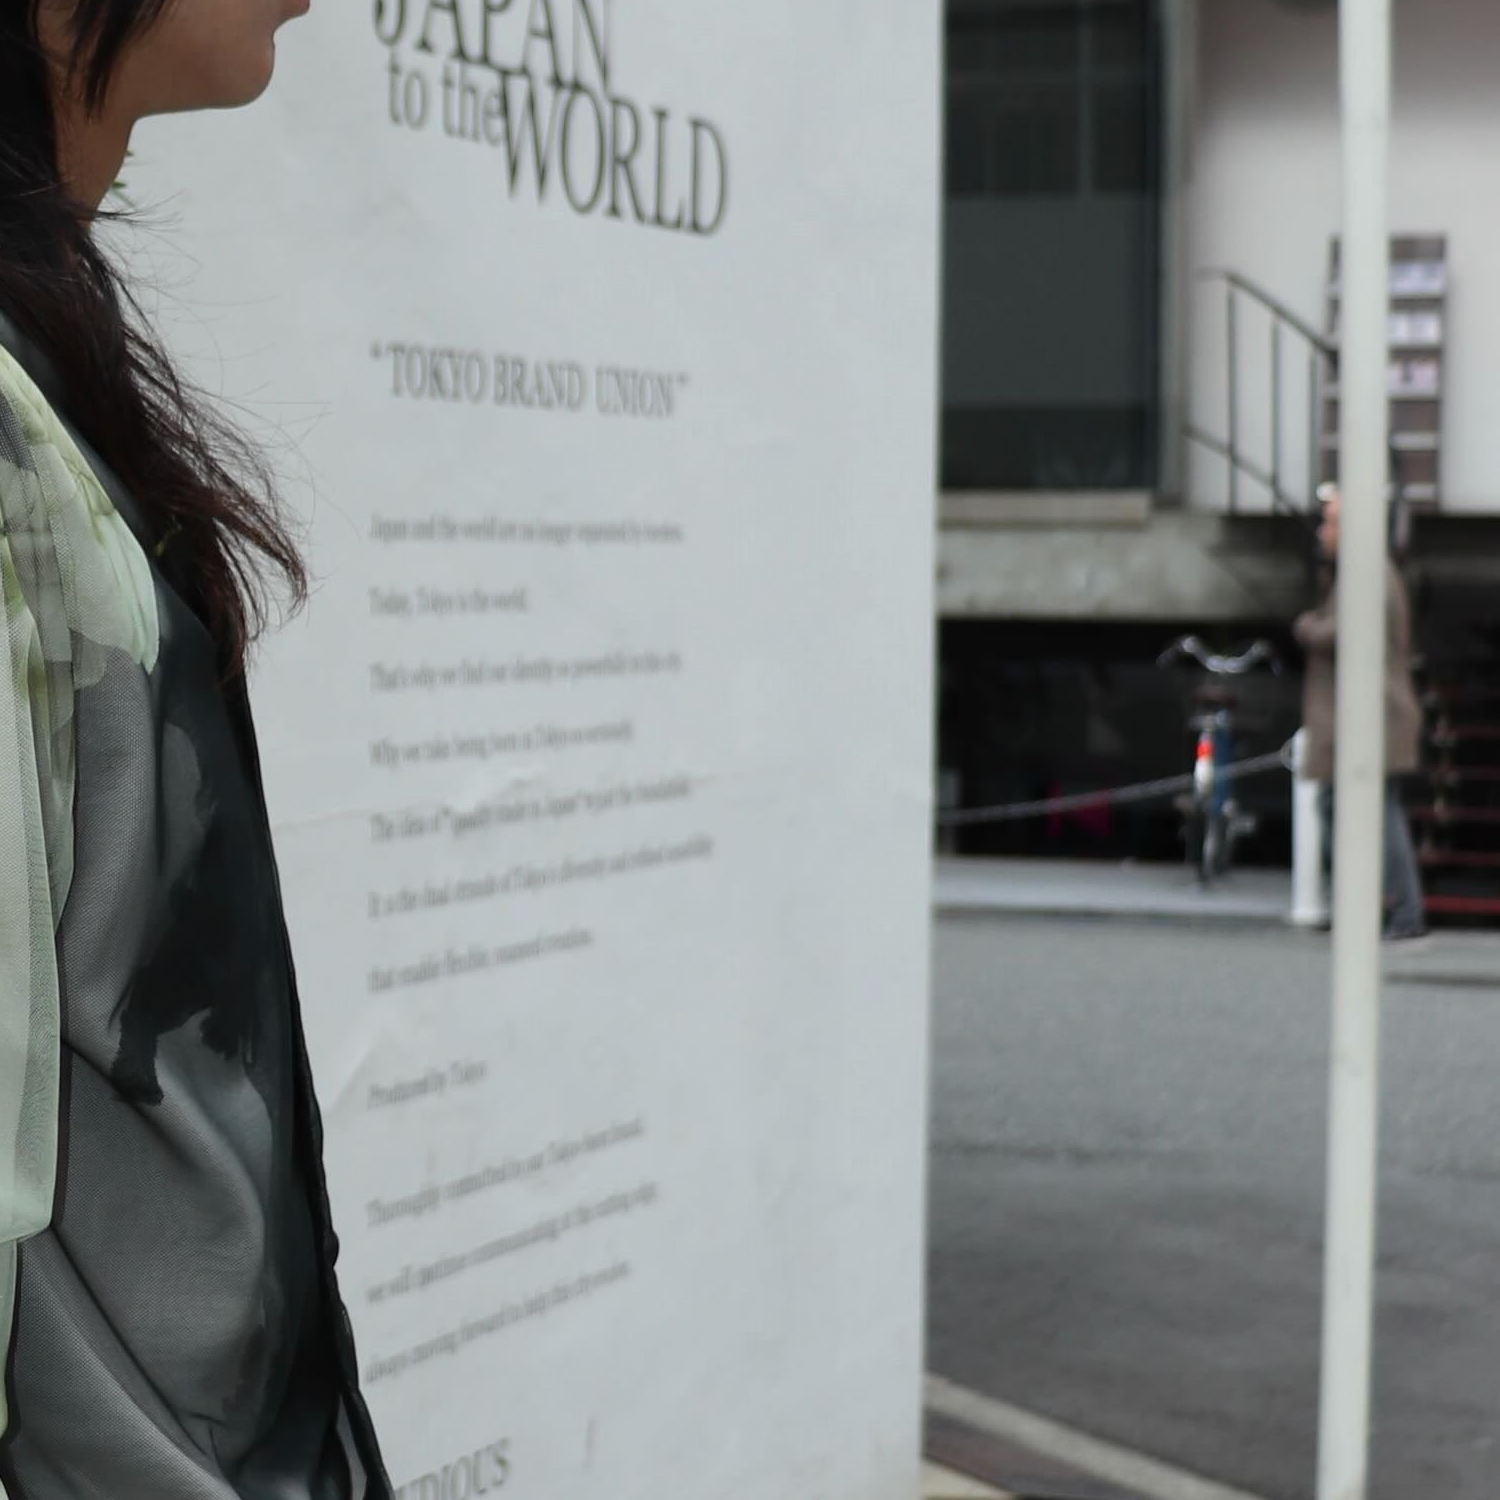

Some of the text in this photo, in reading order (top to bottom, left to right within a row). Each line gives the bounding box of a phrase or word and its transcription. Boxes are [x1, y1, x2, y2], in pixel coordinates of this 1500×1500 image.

[387, 50, 728, 238] to the WORLD
[492, 353, 586, 412] BRAND
